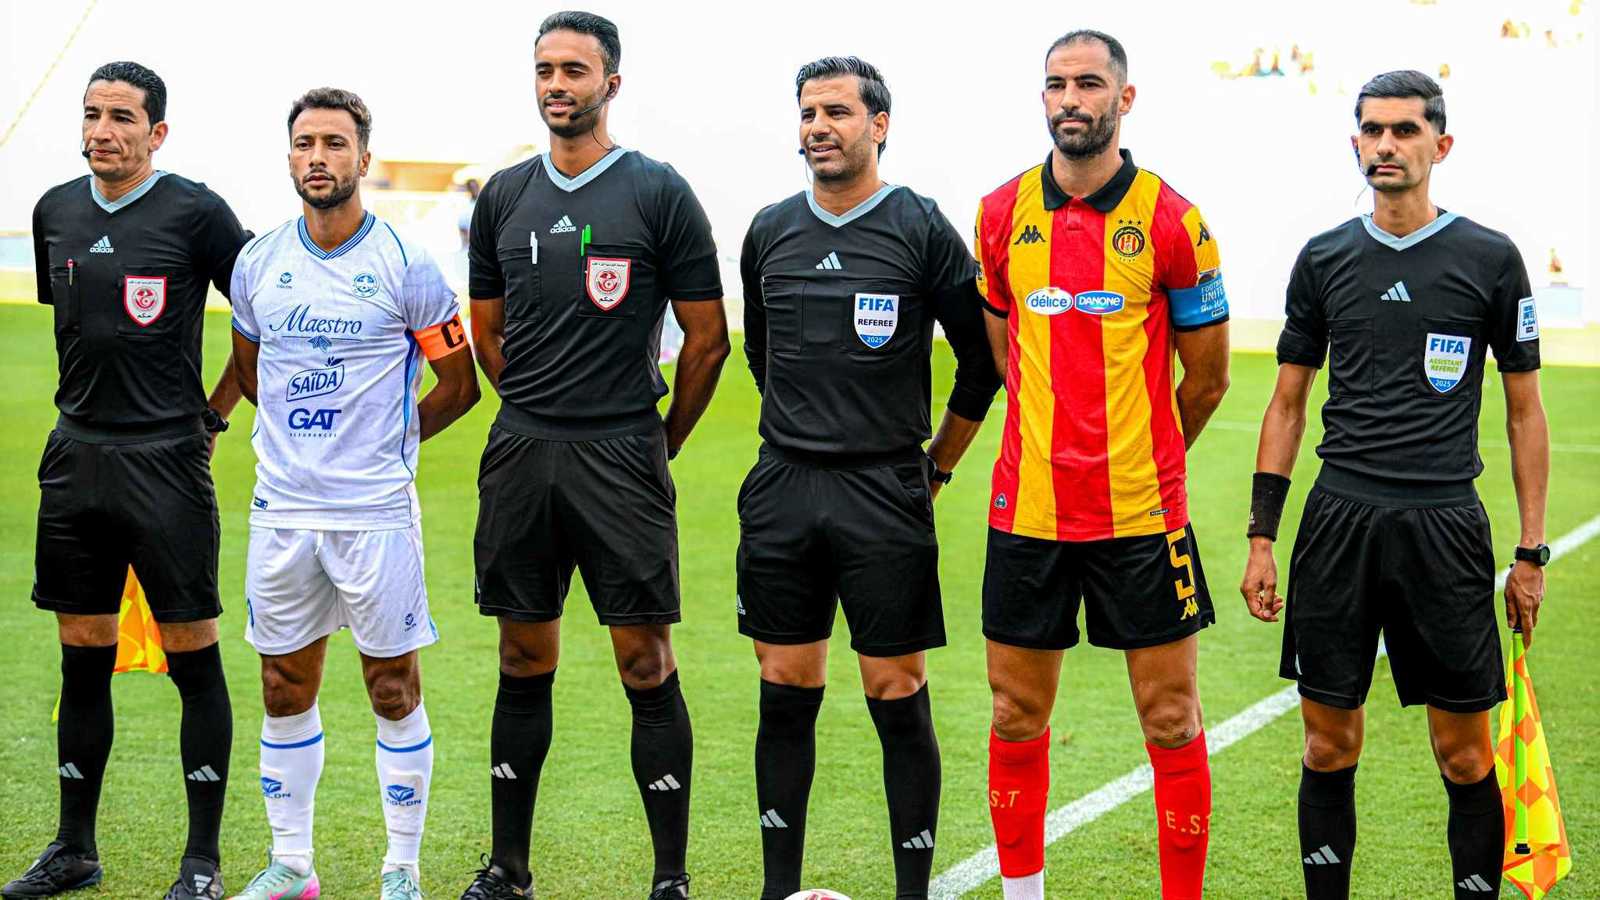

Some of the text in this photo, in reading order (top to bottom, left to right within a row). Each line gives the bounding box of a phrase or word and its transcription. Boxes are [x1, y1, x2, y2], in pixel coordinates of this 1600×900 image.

[549, 225, 577, 234] adidas
[858, 297, 895, 312] FIFA
[1031, 295, 1068, 308] délice
[269, 303, 363, 335] Maestro
[857, 318, 894, 327] REFEREE
[441, 319, 464, 349] C
[1430, 337, 1465, 354] FIFA
[290, 370, 338, 397] SAÏDA
[287, 407, 342, 431] GAT
